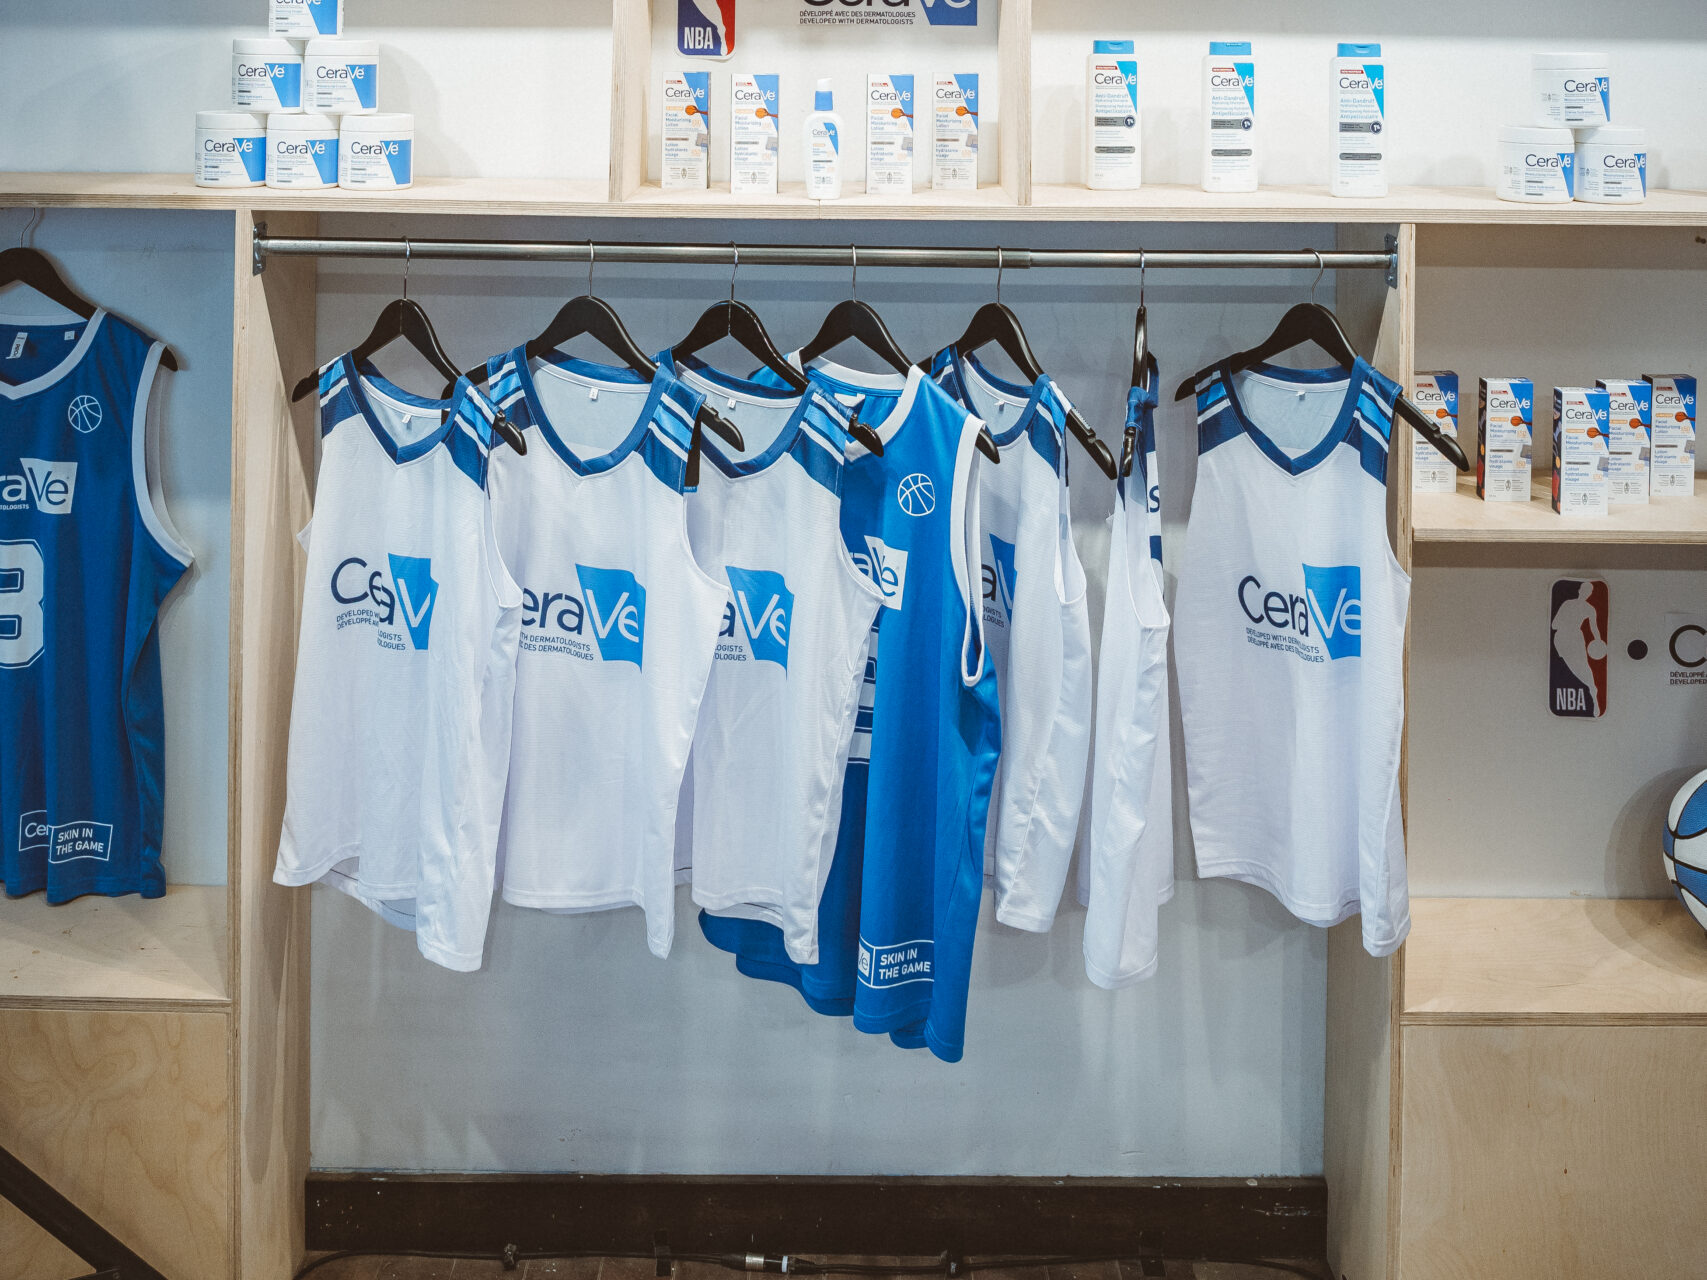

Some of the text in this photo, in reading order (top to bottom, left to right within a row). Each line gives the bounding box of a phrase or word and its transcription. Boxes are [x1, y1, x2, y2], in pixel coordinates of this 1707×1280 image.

[800, 9, 833, 17] DÉVELOPPÉ
[684, 27, 714, 49] NBA
[238, 64, 285, 78] CeraVe
[316, 65, 365, 79] CeraVe
[1094, 73, 1136, 85] CeraVe
[1211, 75, 1254, 87] CeraVe
[1339, 77, 1383, 89] CeraVe
[1564, 79, 1608, 93] CeraVe
[665, 87, 704, 98] CeraVe
[735, 90, 776, 101] CeraVe
[870, 90, 911, 101] CeraVe
[936, 88, 975, 99] CeraVe
[204, 139, 253, 153] CeraVe
[277, 140, 325, 155] CeraVe
[351, 141, 399, 155] CeraVe
[1525, 154, 1571, 168] CeraVe
[1603, 155, 1646, 169] CeraVe
[1415, 390, 1456, 402] CeraVe
[1490, 397, 1531, 409] CeraVe
[1655, 393, 1694, 405] CeraVe
[1609, 400, 1649, 411] CeraVe
[1565, 408, 1607, 420] CeraVe
[0, 467, 69, 506] aVe
[851, 547, 898, 597] aVe
[1238, 575, 1361, 639] CeraVe
[336, 609, 374, 623] DEVELOPED
[522, 587, 639, 643] eraVe
[718, 589, 787, 647] aVe
[530, 635, 591, 651] DERMATOLOGISTS
[1271, 634, 1287, 642] WITH
[524, 642, 594, 660] DES DERMATOLOGUES
[1270, 642, 1285, 651] AVEC
[715, 653, 747, 661] OLOGUES
[1670, 670, 1704, 678] DÉVELOPPÉ
[1556, 687, 1586, 711] NBA
[25, 822, 48, 838] Cer
[58, 827, 93, 842] SKIN IN
[56, 840, 104, 855] THE GAME
[880, 951, 906, 966] SKIN
[907, 947, 918, 960] IN
[879, 961, 931, 980] THE GAME
